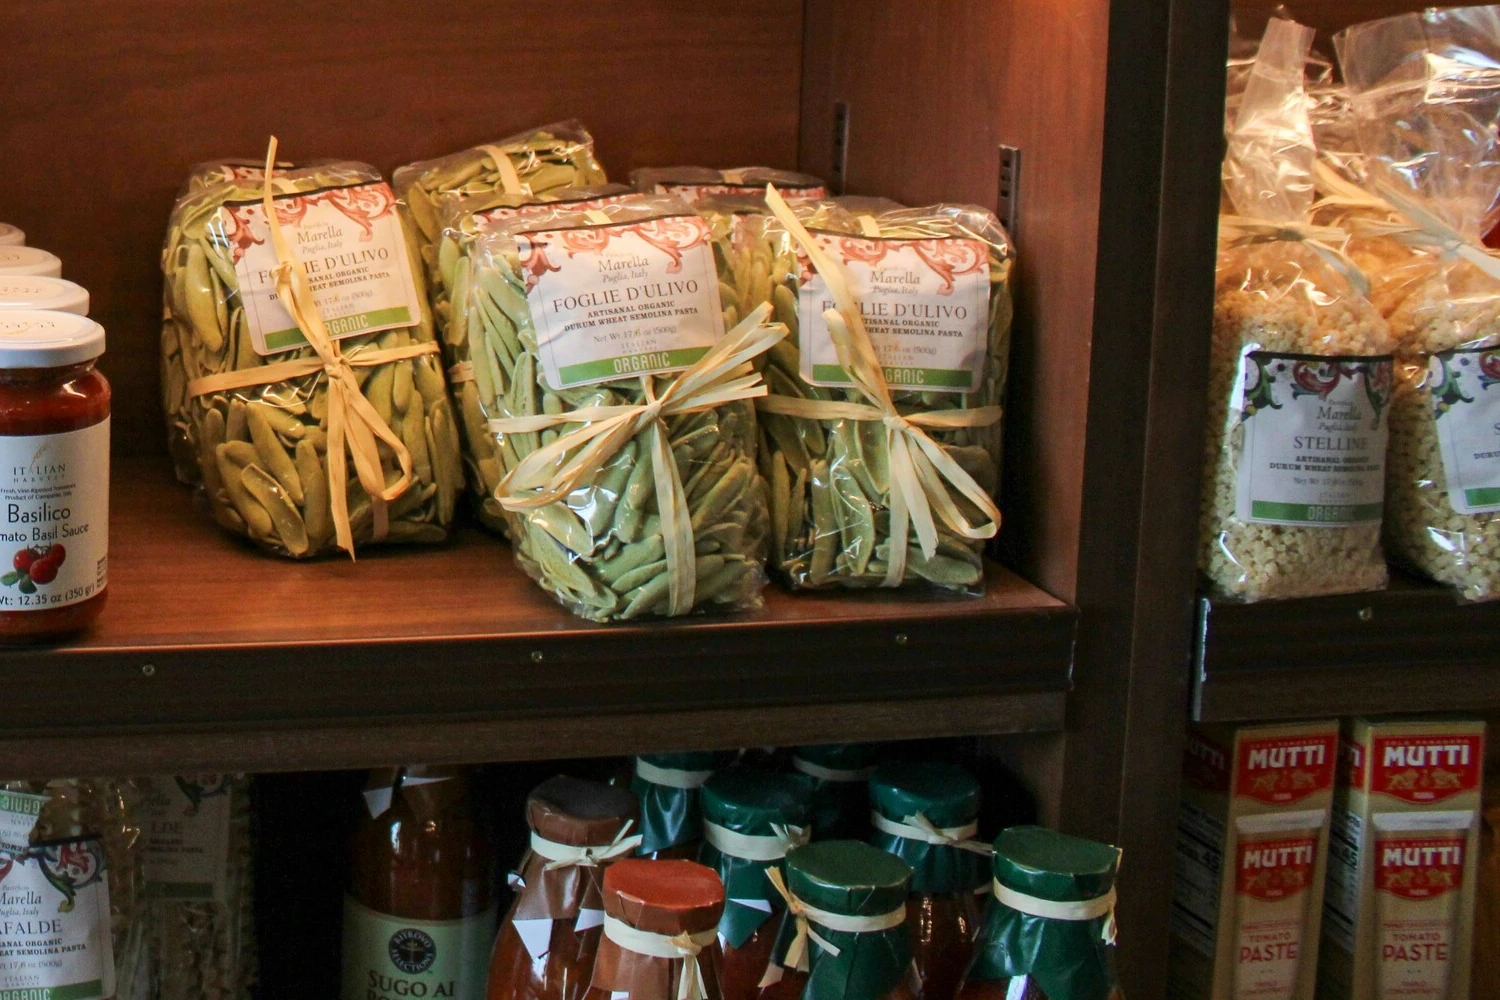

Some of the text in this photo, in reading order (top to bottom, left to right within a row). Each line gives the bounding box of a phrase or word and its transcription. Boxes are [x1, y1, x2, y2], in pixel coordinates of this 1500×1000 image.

[297, 228, 343, 245] Marella
[326, 248, 389, 270] D'ULIVO
[599, 255, 649, 272] Marella
[337, 267, 368, 278] ORGANIC
[870, 271, 920, 285] Marella
[553, 280, 698, 313] FOGLIE D'ULIVO
[588, 300, 674, 318] ARTISANAL ORGANIC
[894, 303, 967, 319] D'ULIVO
[564, 307, 698, 331] DURUM WHEAT SEMOLINA PASTA
[893, 328, 963, 337] SEMOLINA PASTA
[614, 352, 670, 373] ORGANIC
[1294, 436, 1367, 450] STELLINE
[8, 503, 71, 523] Basilico
[32, 526, 58, 541] Basil
[62, 523, 89, 538] Sauce
[18, 594, 48, 605] 12.35
[51, 594, 61, 603] oz
[1248, 746, 1325, 769] MUTTI
[1384, 746, 1468, 767] MUTTI
[1244, 847, 1312, 869] MUTTI
[1383, 847, 1460, 866] MUTTI
[26, 938, 62, 946] ORGANIC
[1392, 933, 1440, 942] TOMATO
[17, 947, 59, 956] SEMOLINA
[62, 944, 86, 952] PASTA
[1240, 943, 1297, 963] PASTE
[1383, 944, 1447, 961] PASTE
[368, 970, 427, 997] SUGO
